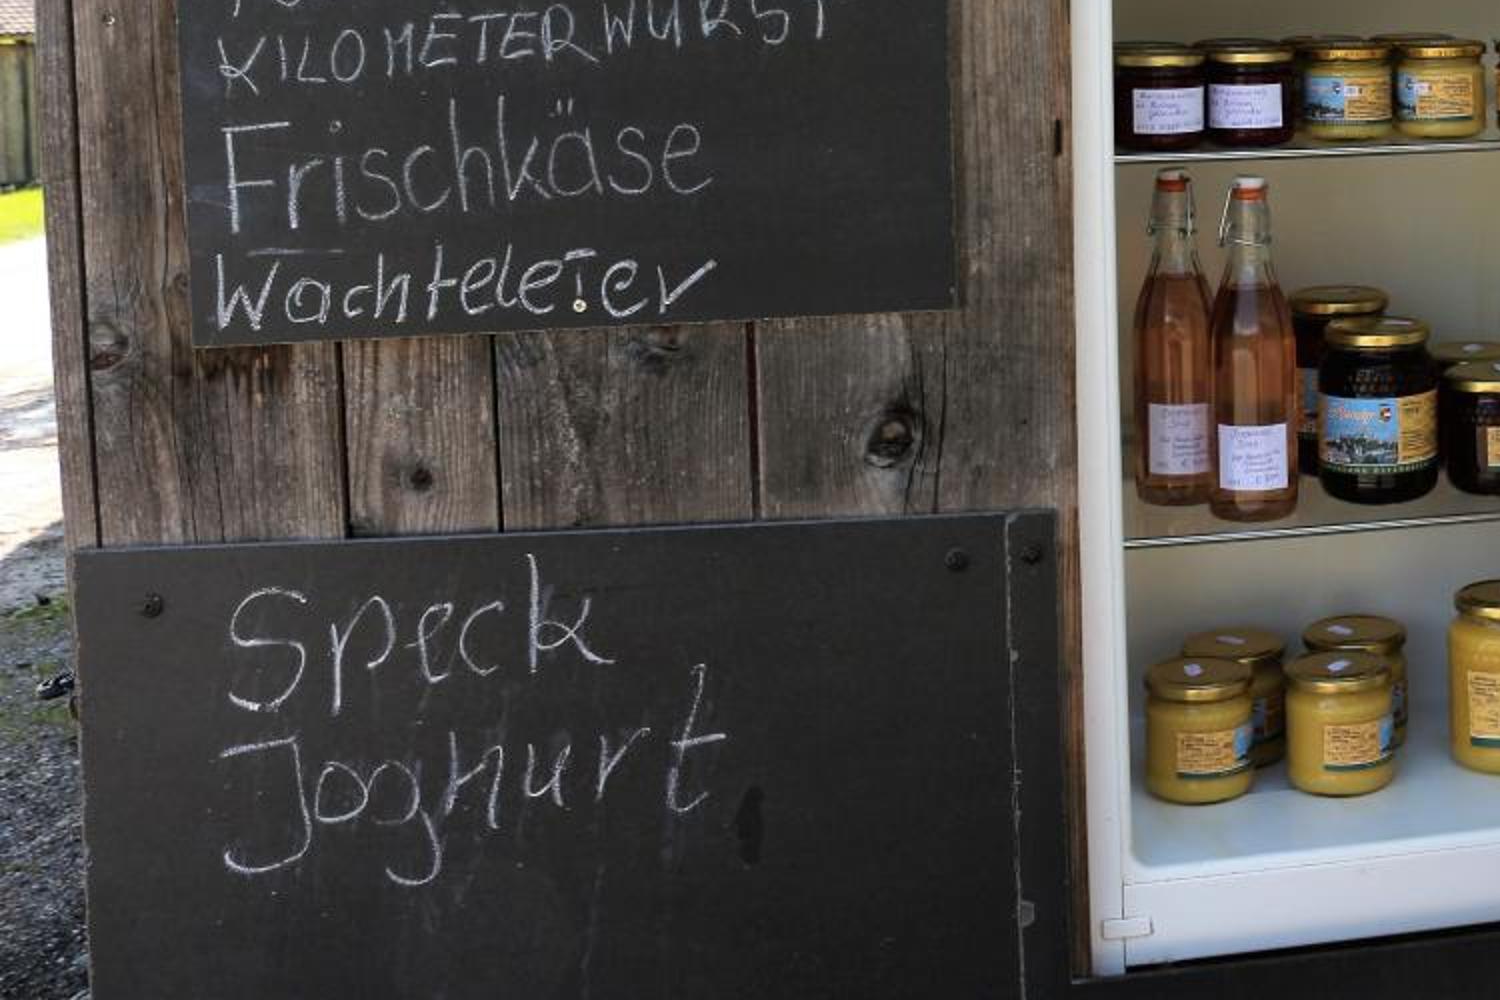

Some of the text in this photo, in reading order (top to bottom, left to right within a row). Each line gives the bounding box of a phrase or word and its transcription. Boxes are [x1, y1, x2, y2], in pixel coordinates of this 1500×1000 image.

[220, 94, 714, 234] Frischkäse
[226, 552, 617, 716] Speck
[219, 662, 728, 887] Joghurt
